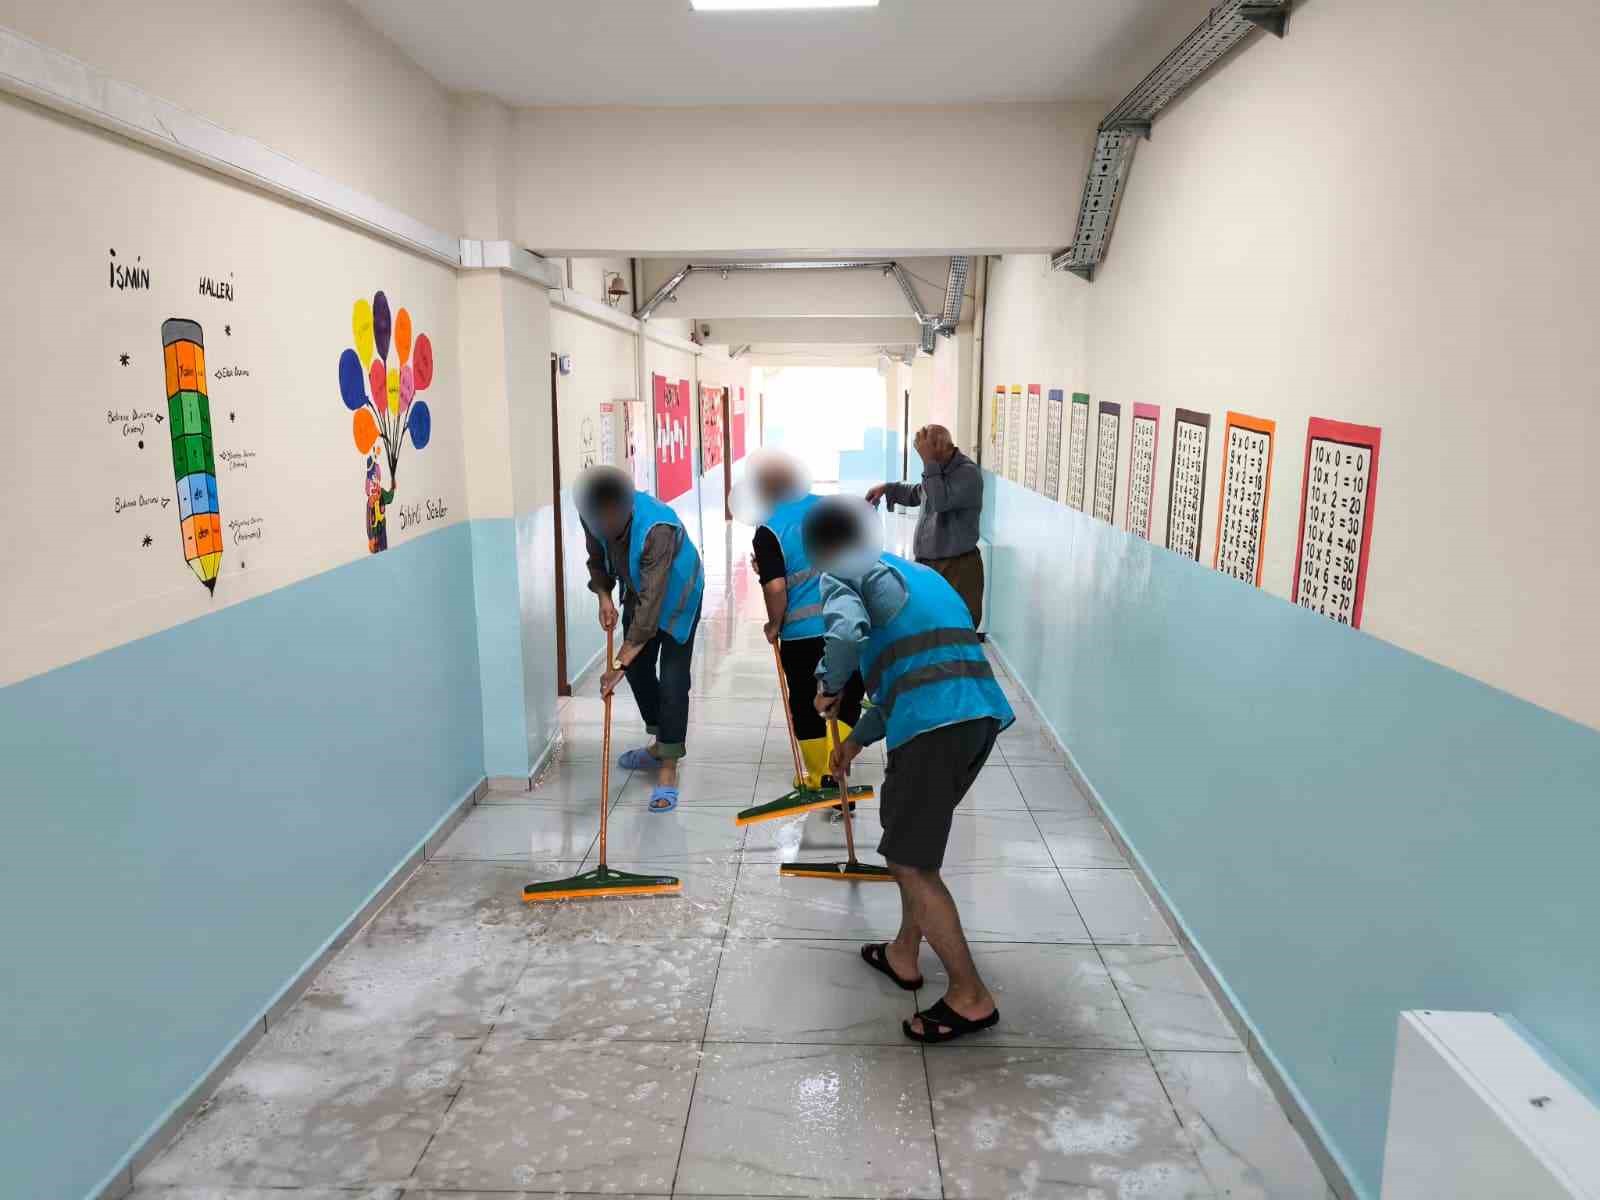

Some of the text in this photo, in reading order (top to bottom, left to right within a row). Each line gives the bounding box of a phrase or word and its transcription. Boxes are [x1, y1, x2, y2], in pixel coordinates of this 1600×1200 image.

[199, 271, 234, 302] HALLERİ
[1315, 446, 1363, 472] 10 x 0 = 0
[1313, 466, 1364, 494] 10 x 1 = 10
[1312, 485, 1360, 514] 10 x 2 = 20
[1310, 506, 1358, 536] 10 x 3 = 30
[1308, 524, 1356, 554] 10 x 4 = 40
[1306, 542, 1354, 574] 10 x 5 = 50
[1304, 560, 1352, 592] 10 x 6 = 60
[1303, 578, 1350, 610] 10 x 7 = 70
